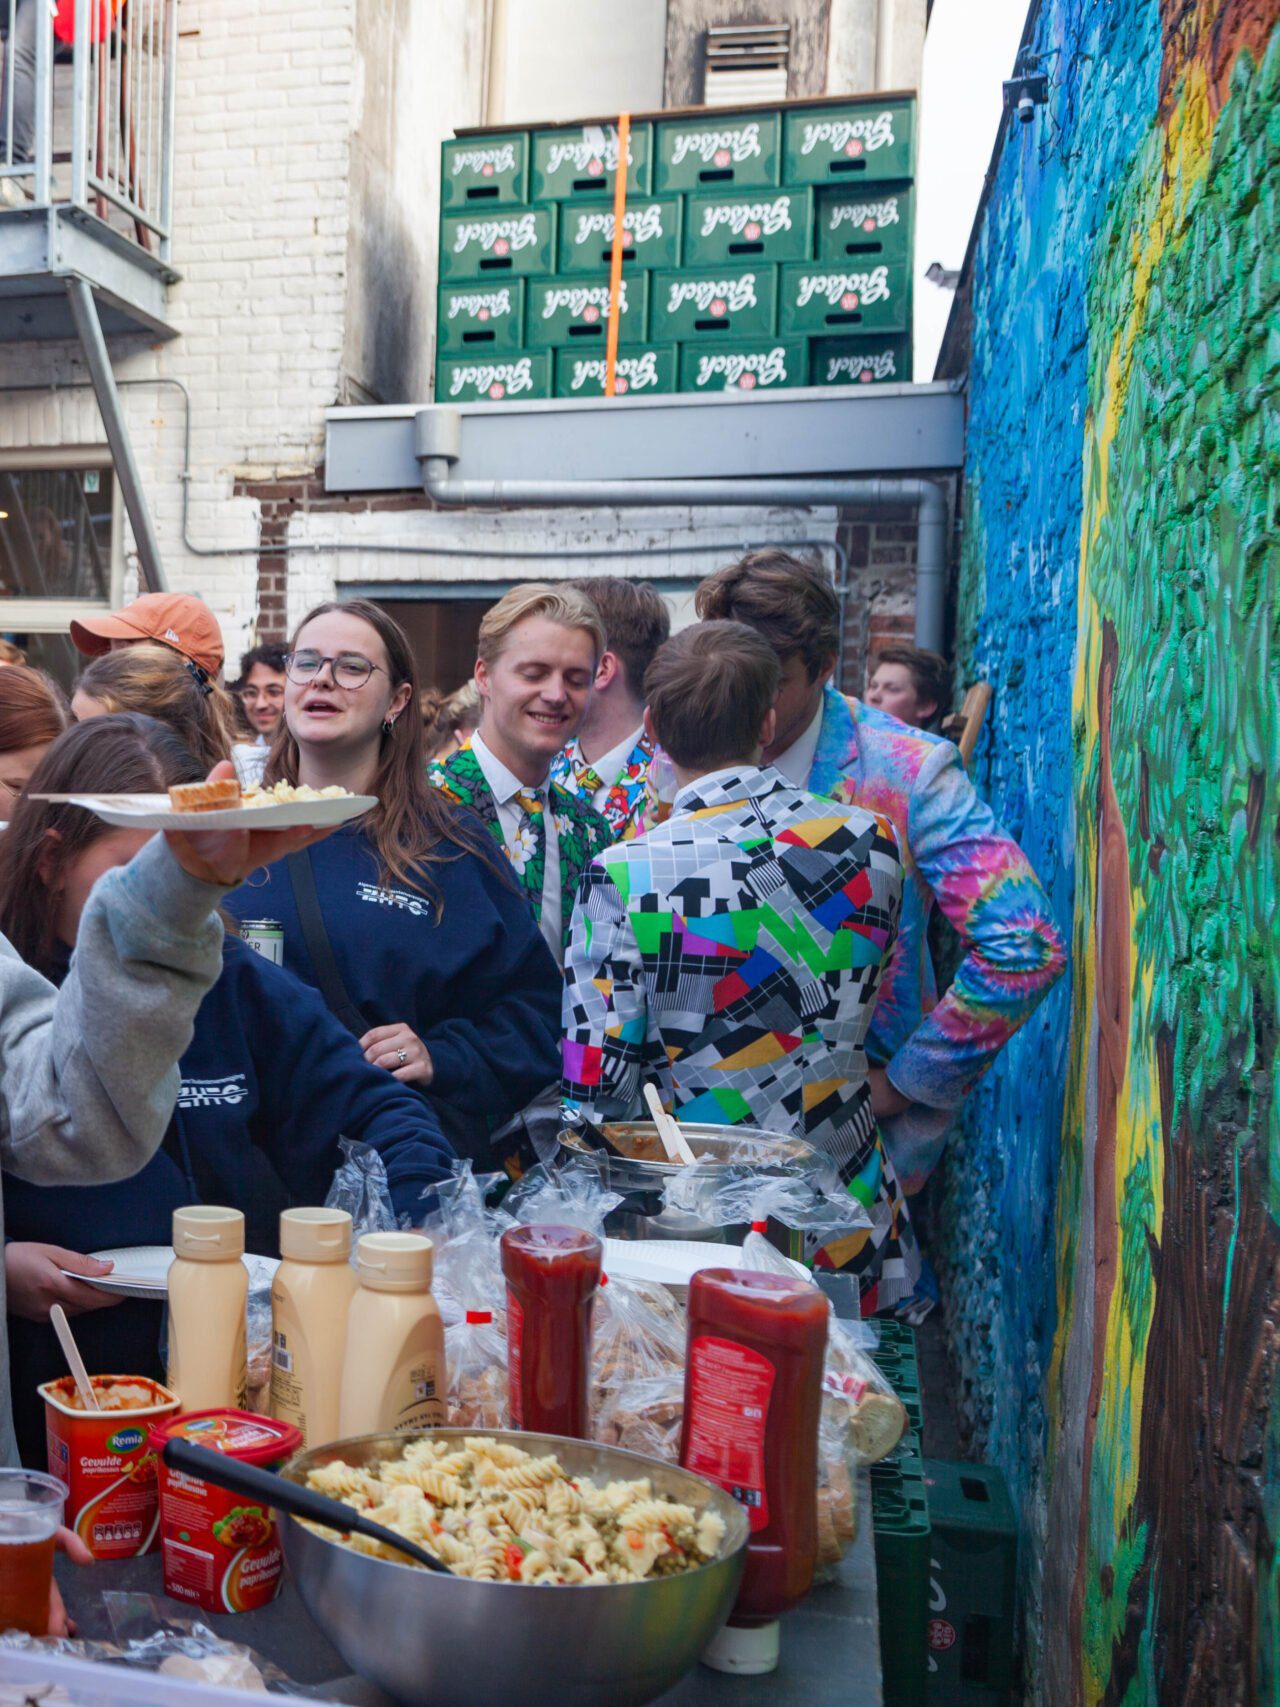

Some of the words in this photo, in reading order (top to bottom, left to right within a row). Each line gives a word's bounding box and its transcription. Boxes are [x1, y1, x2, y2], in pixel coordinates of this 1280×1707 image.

[672, 123, 761, 165] Grolsch
[801, 112, 894, 156] Grolsch
[453, 144, 515, 175] Grolsch
[454, 213, 537, 254] Grolsch
[701, 196, 791, 238] Grolsch
[830, 198, 899, 231] Grolsch
[448, 289, 510, 319] Grolsch
[668, 274, 757, 313] Grolsch
[797, 266, 890, 308] Grolsch
[450, 358, 533, 397] Grolsch
[697, 347, 787, 387] Grolsch
[827, 351, 896, 381] Grolsch
[112, 1434, 144, 1448] Remia
[80, 1456, 122, 1467] Gevulde
[240, 1547, 281, 1574] Gevuld
